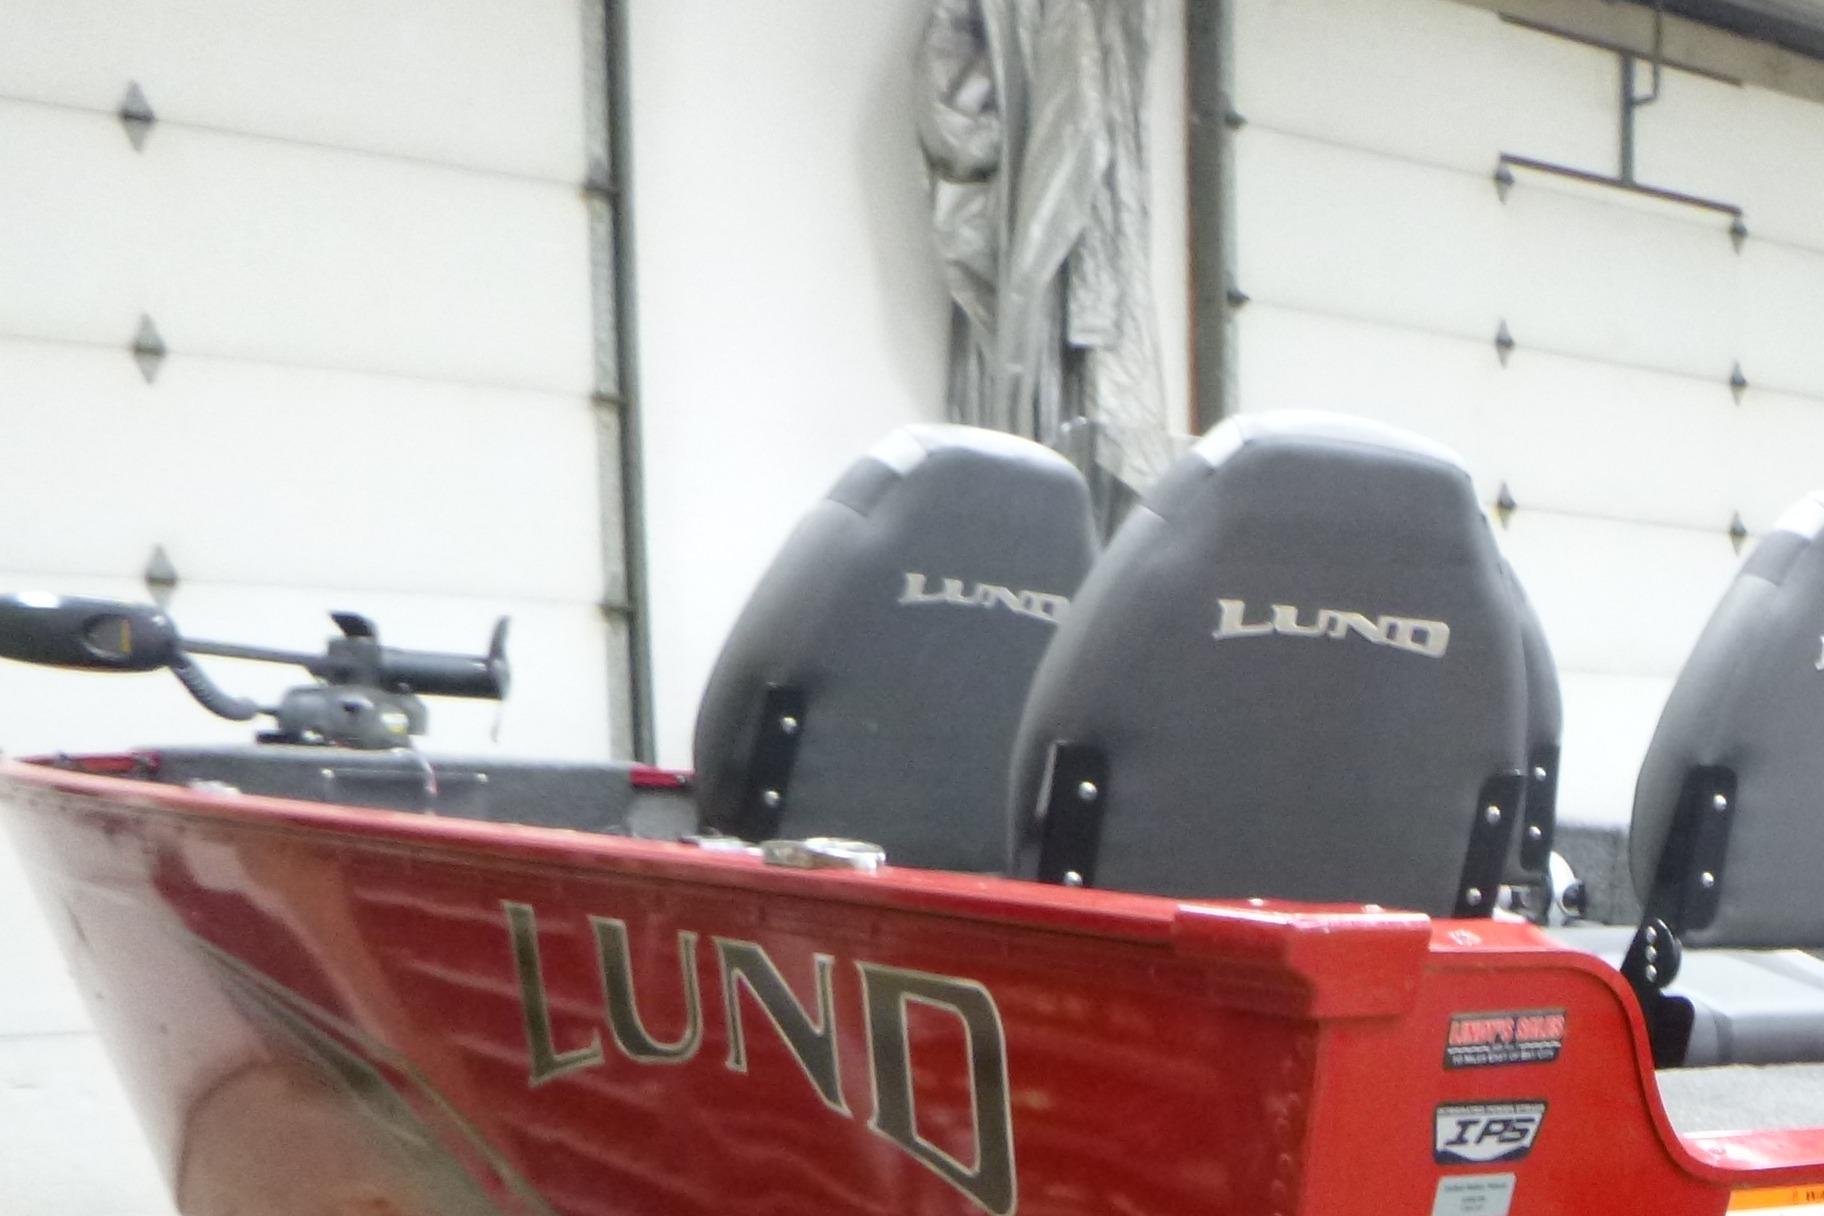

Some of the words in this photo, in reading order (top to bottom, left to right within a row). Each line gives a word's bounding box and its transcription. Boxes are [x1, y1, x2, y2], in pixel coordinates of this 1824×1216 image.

[900, 572, 1070, 625] LUND
[1212, 598, 1450, 659] LUND
[1444, 1117, 1536, 1146] IPS
